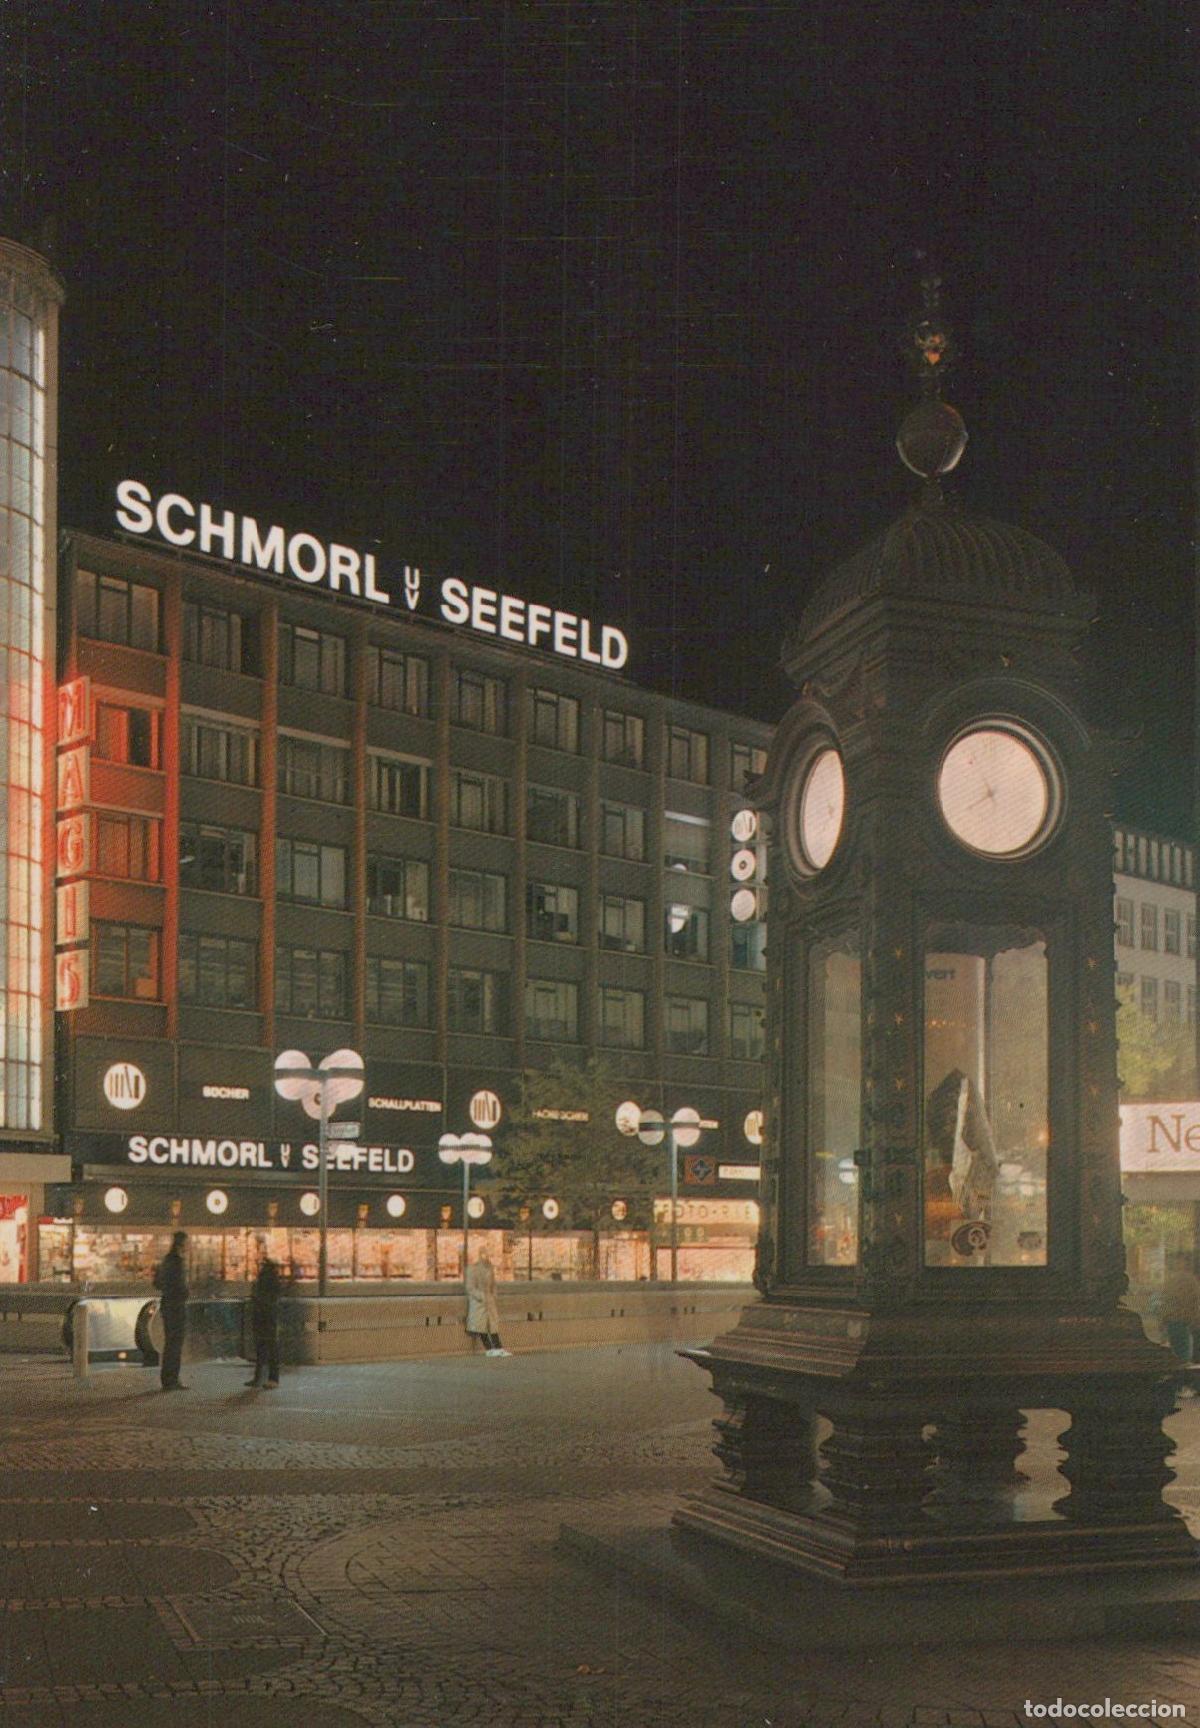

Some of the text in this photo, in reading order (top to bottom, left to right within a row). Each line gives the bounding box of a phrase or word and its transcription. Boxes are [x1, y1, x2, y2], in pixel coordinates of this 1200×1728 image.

[116, 479, 390, 604] SCHMORL
[440, 577, 628, 669] SEEFELD
[58, 682, 86, 1007] MAGIS
[127, 1135, 273, 1168] SCHMORL
